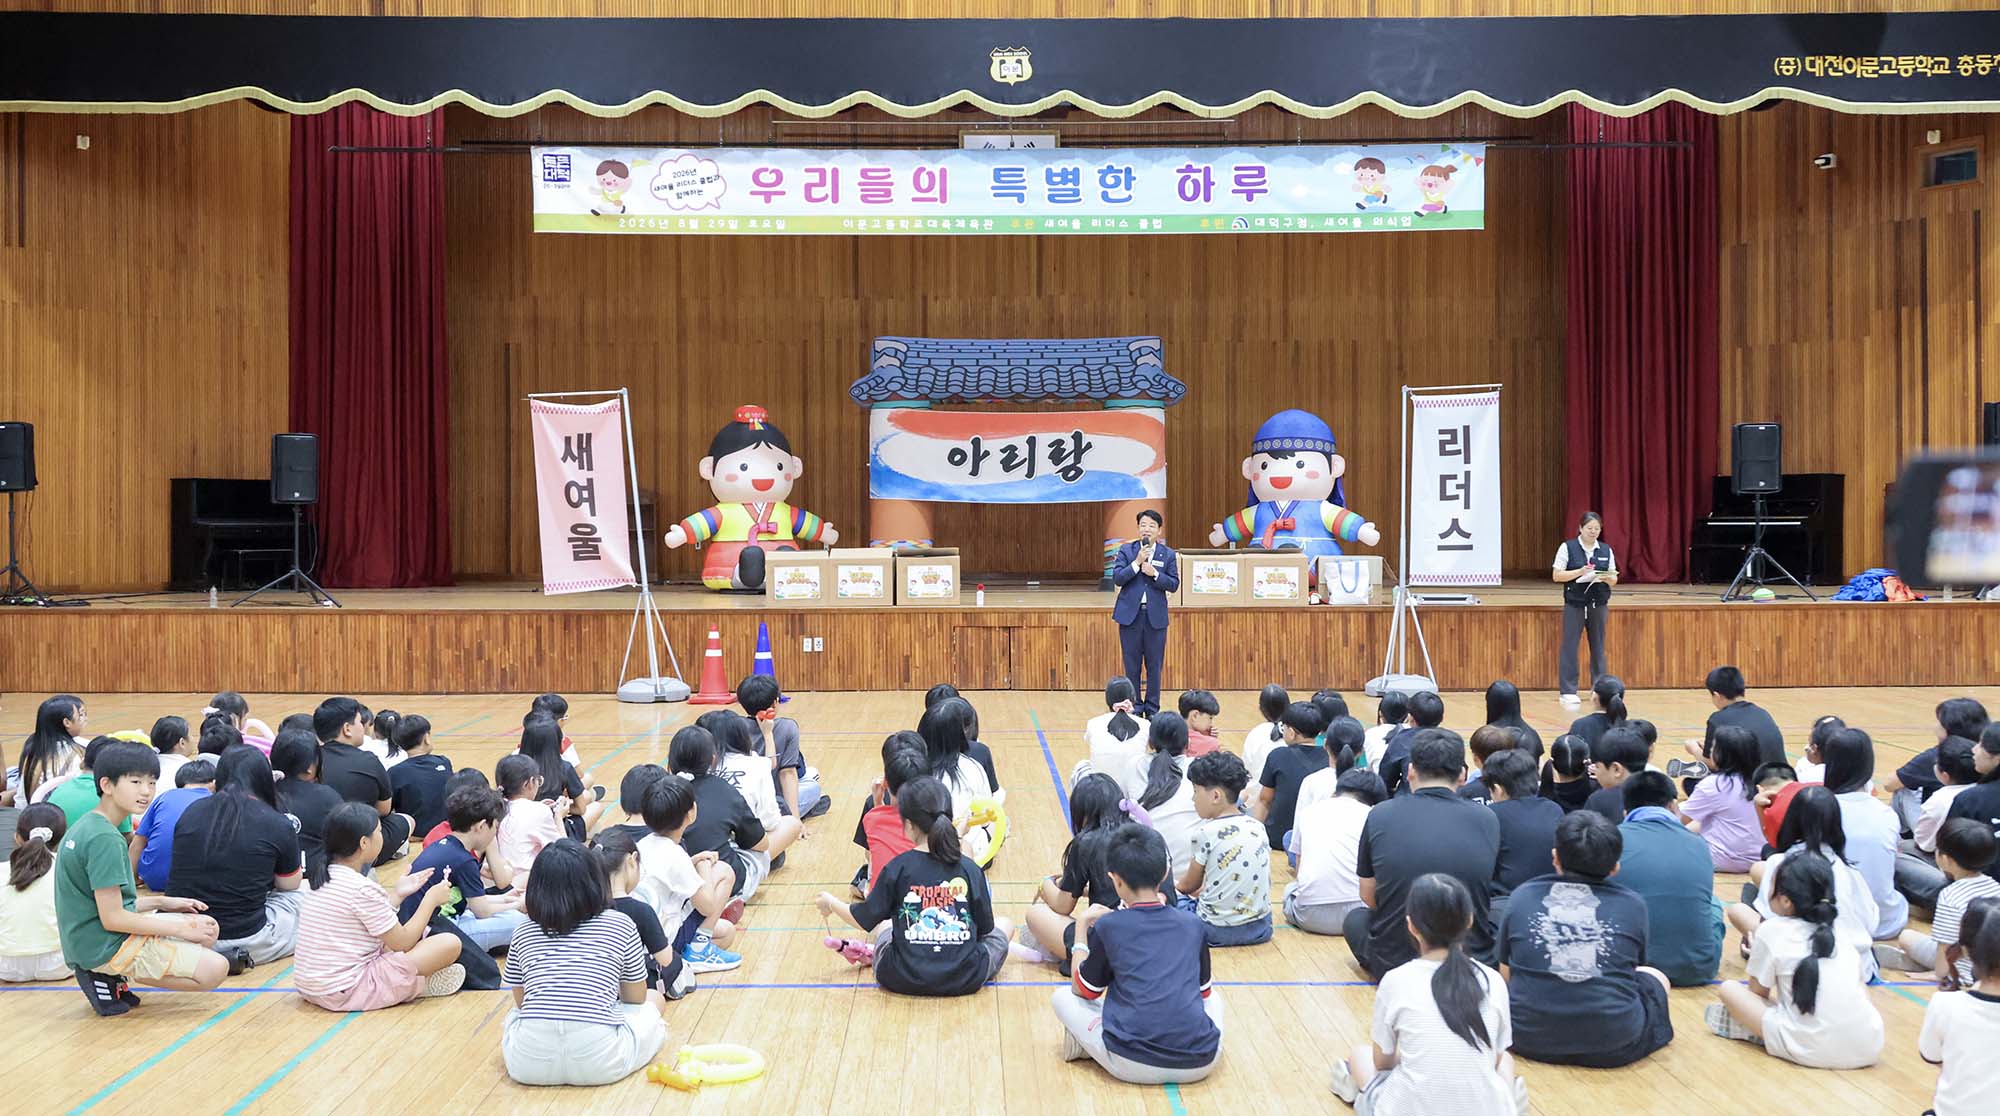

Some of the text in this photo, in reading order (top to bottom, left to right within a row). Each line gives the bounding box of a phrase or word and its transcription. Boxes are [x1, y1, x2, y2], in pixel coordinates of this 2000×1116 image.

[1805, 55, 1951, 78] 대전이문고등학교
[672, 168, 697, 179] 2026년
[676, 179, 697, 187] 리더스
[750, 164, 1269, 204] 우리들의 특별한 하루
[619, 218, 669, 230] 2026년
[708, 218, 738, 230] 29일
[1091, 218, 1128, 228] 리더스
[947, 430, 1093, 482] 아리랑
[561, 432, 602, 562] 새여울
[1437, 425, 1474, 551] 리더스
[904, 929, 971, 941] UMBRO
